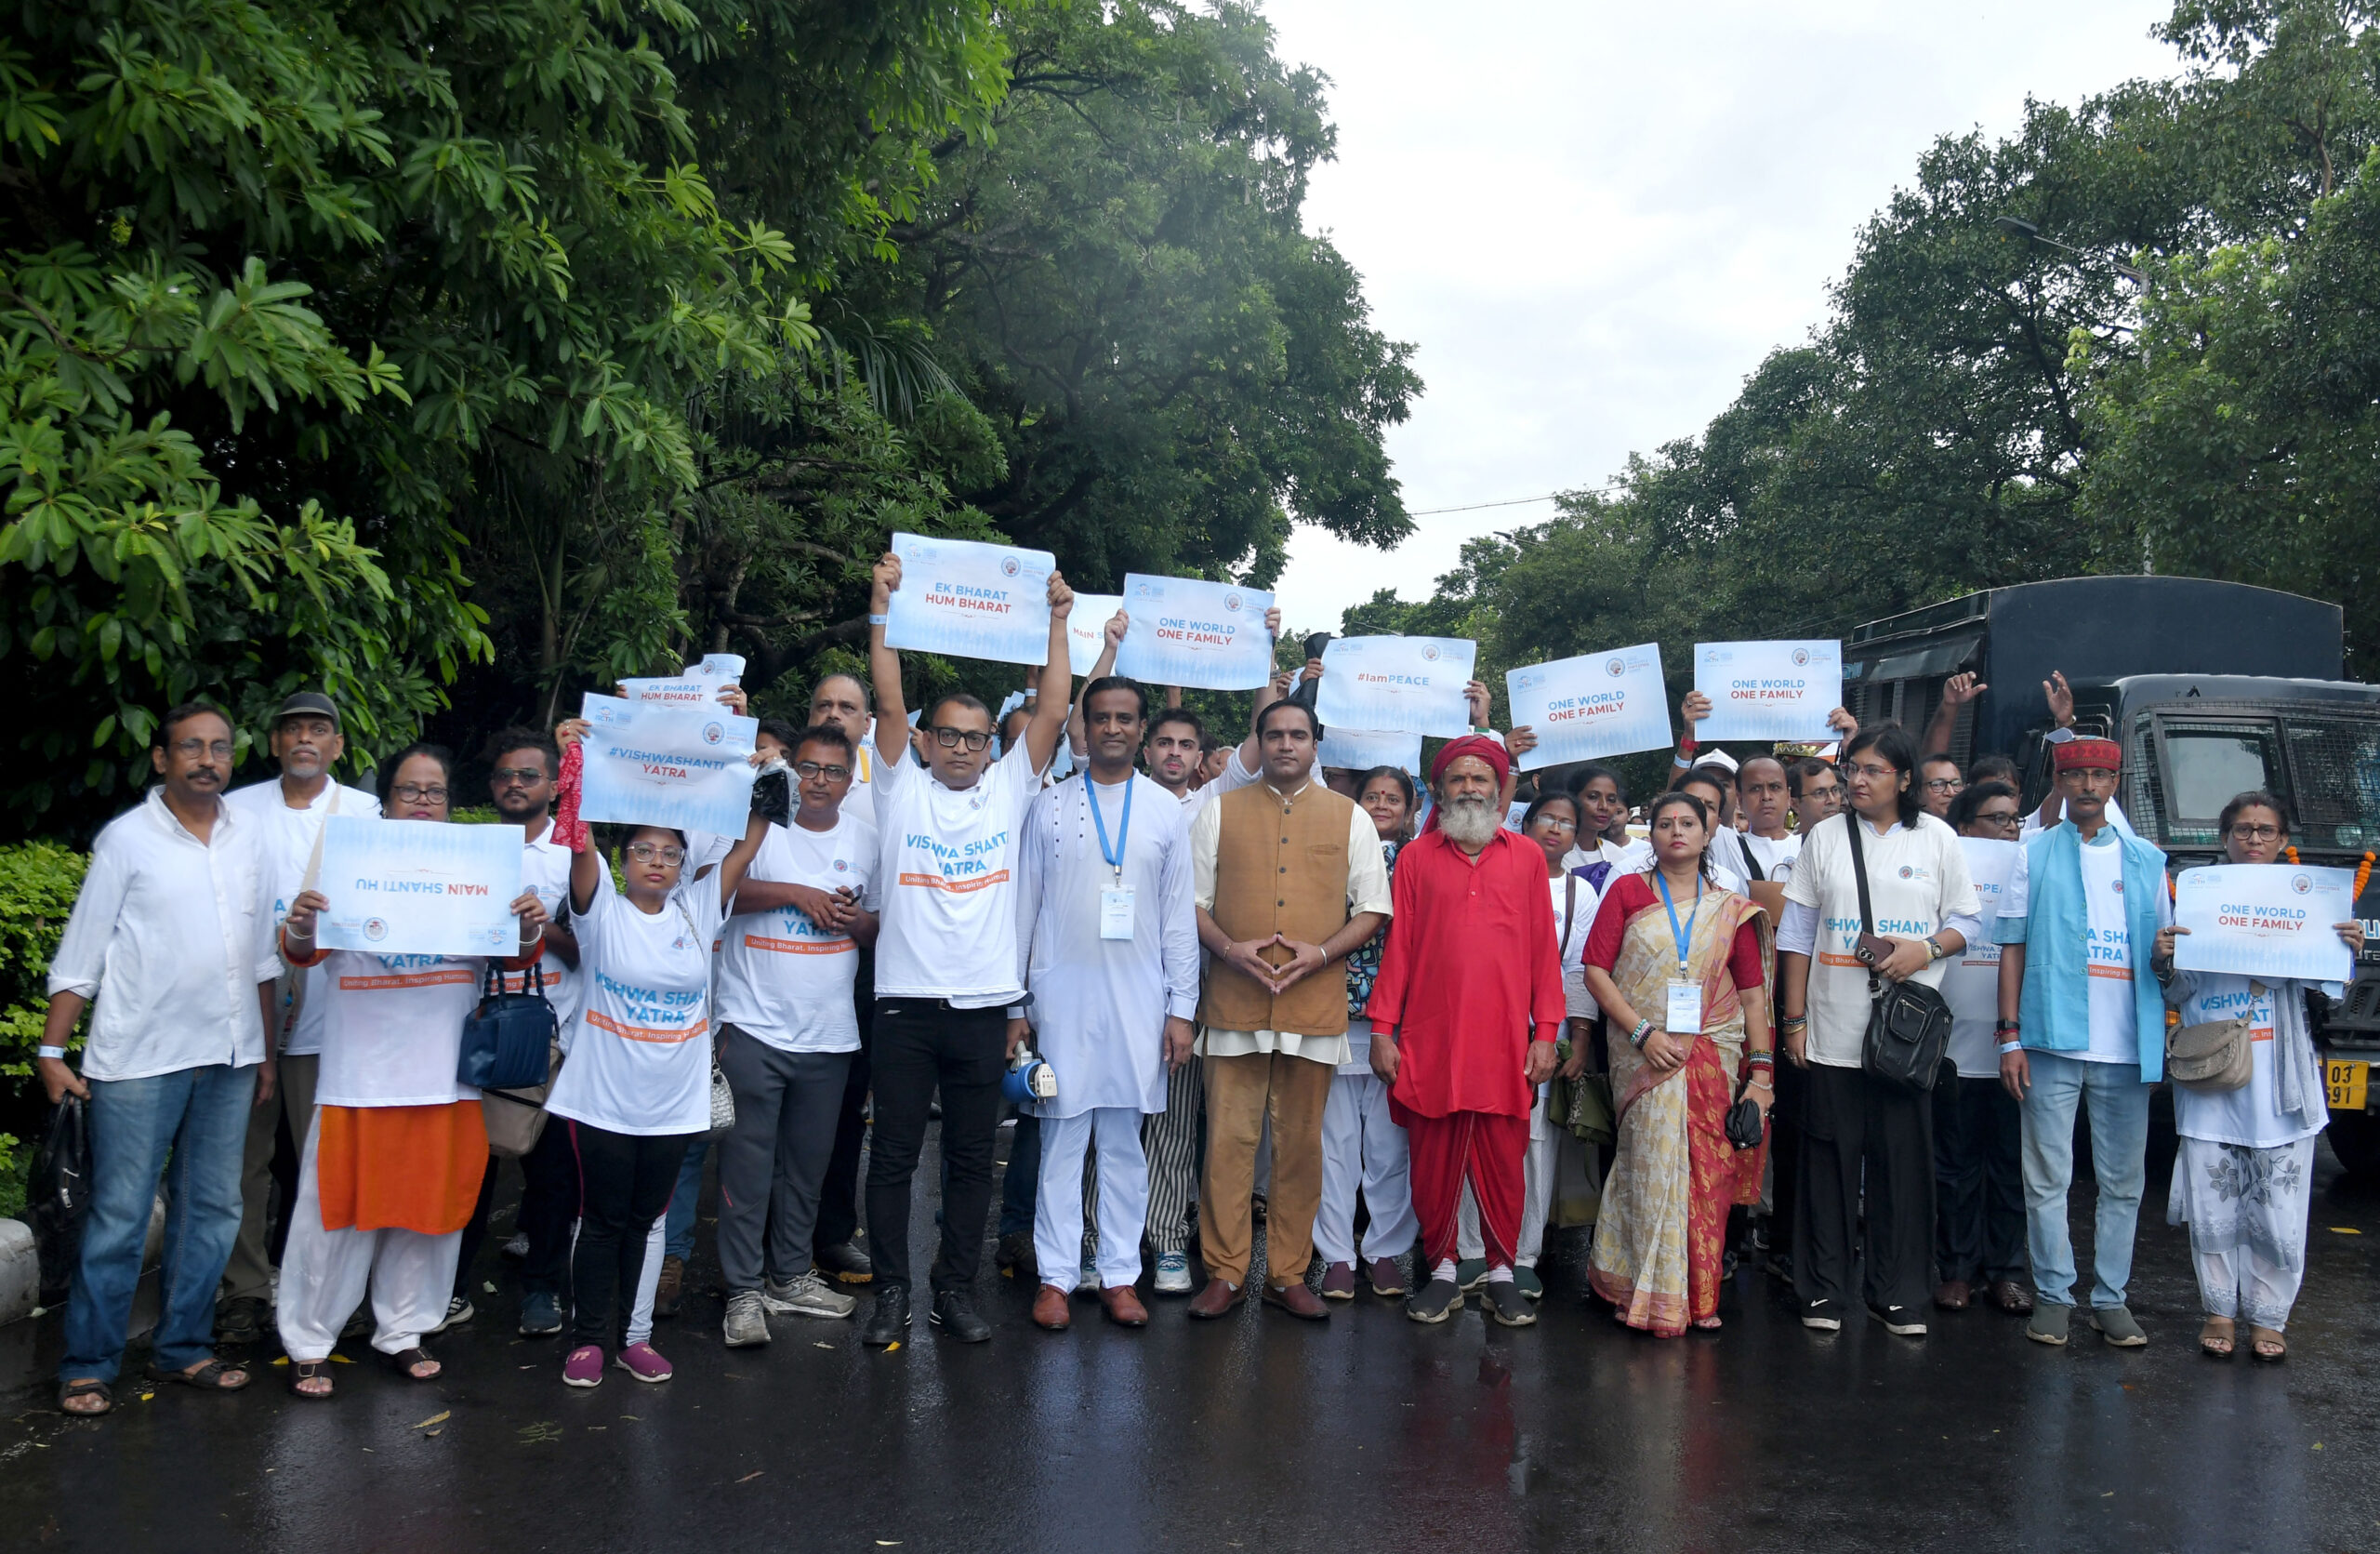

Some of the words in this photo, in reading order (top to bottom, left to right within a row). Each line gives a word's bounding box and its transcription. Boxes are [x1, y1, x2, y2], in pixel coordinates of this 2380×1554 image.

[935, 582, 951, 593] EK
[956, 584, 1008, 601] BHARAT
[926, 593, 955, 606] HUM
[959, 598, 1012, 614] BHARAT
[1073, 628, 1094, 639] MAIN
[1159, 618, 1185, 629] ONE
[1190, 620, 1235, 634] WORLD
[1157, 629, 1183, 640] ONE
[1186, 631, 1233, 645] FAMILY
[1357, 672, 1430, 686] #IamPEACE
[1732, 680, 1757, 688] ONE
[1762, 679, 1805, 688] WORLD
[641, 692, 662, 700] HUM
[664, 693, 704, 702] BHARAT
[1548, 698, 1574, 711] ONE
[1578, 690, 1625, 706] WORLD
[1731, 690, 1756, 699] ONE
[1760, 690, 1804, 699] FAMILY
[1549, 710, 1575, 723] ONE
[1579, 702, 1624, 718] FAMILY
[609, 747, 725, 770] #VISHWASHANTI
[642, 764, 686, 778] YATRA
[906, 834, 959, 858] VISWA
[356, 879, 378, 891] HU
[383, 881, 443, 894] SHANTI
[448, 883, 488, 896] MAIN
[2220, 904, 2250, 915] ONE
[2254, 906, 2306, 919] WORLD
[1877, 919, 1928, 935] SHANT
[2218, 916, 2247, 927] ONE
[2252, 918, 2304, 931] FAMILY
[2087, 946, 2123, 962] TRA
[2089, 967, 2121, 977] Inspiring
[405, 975, 442, 985] Inspiring
[625, 1004, 685, 1024] YATRA
[2332, 1066, 2352, 1083] 03
